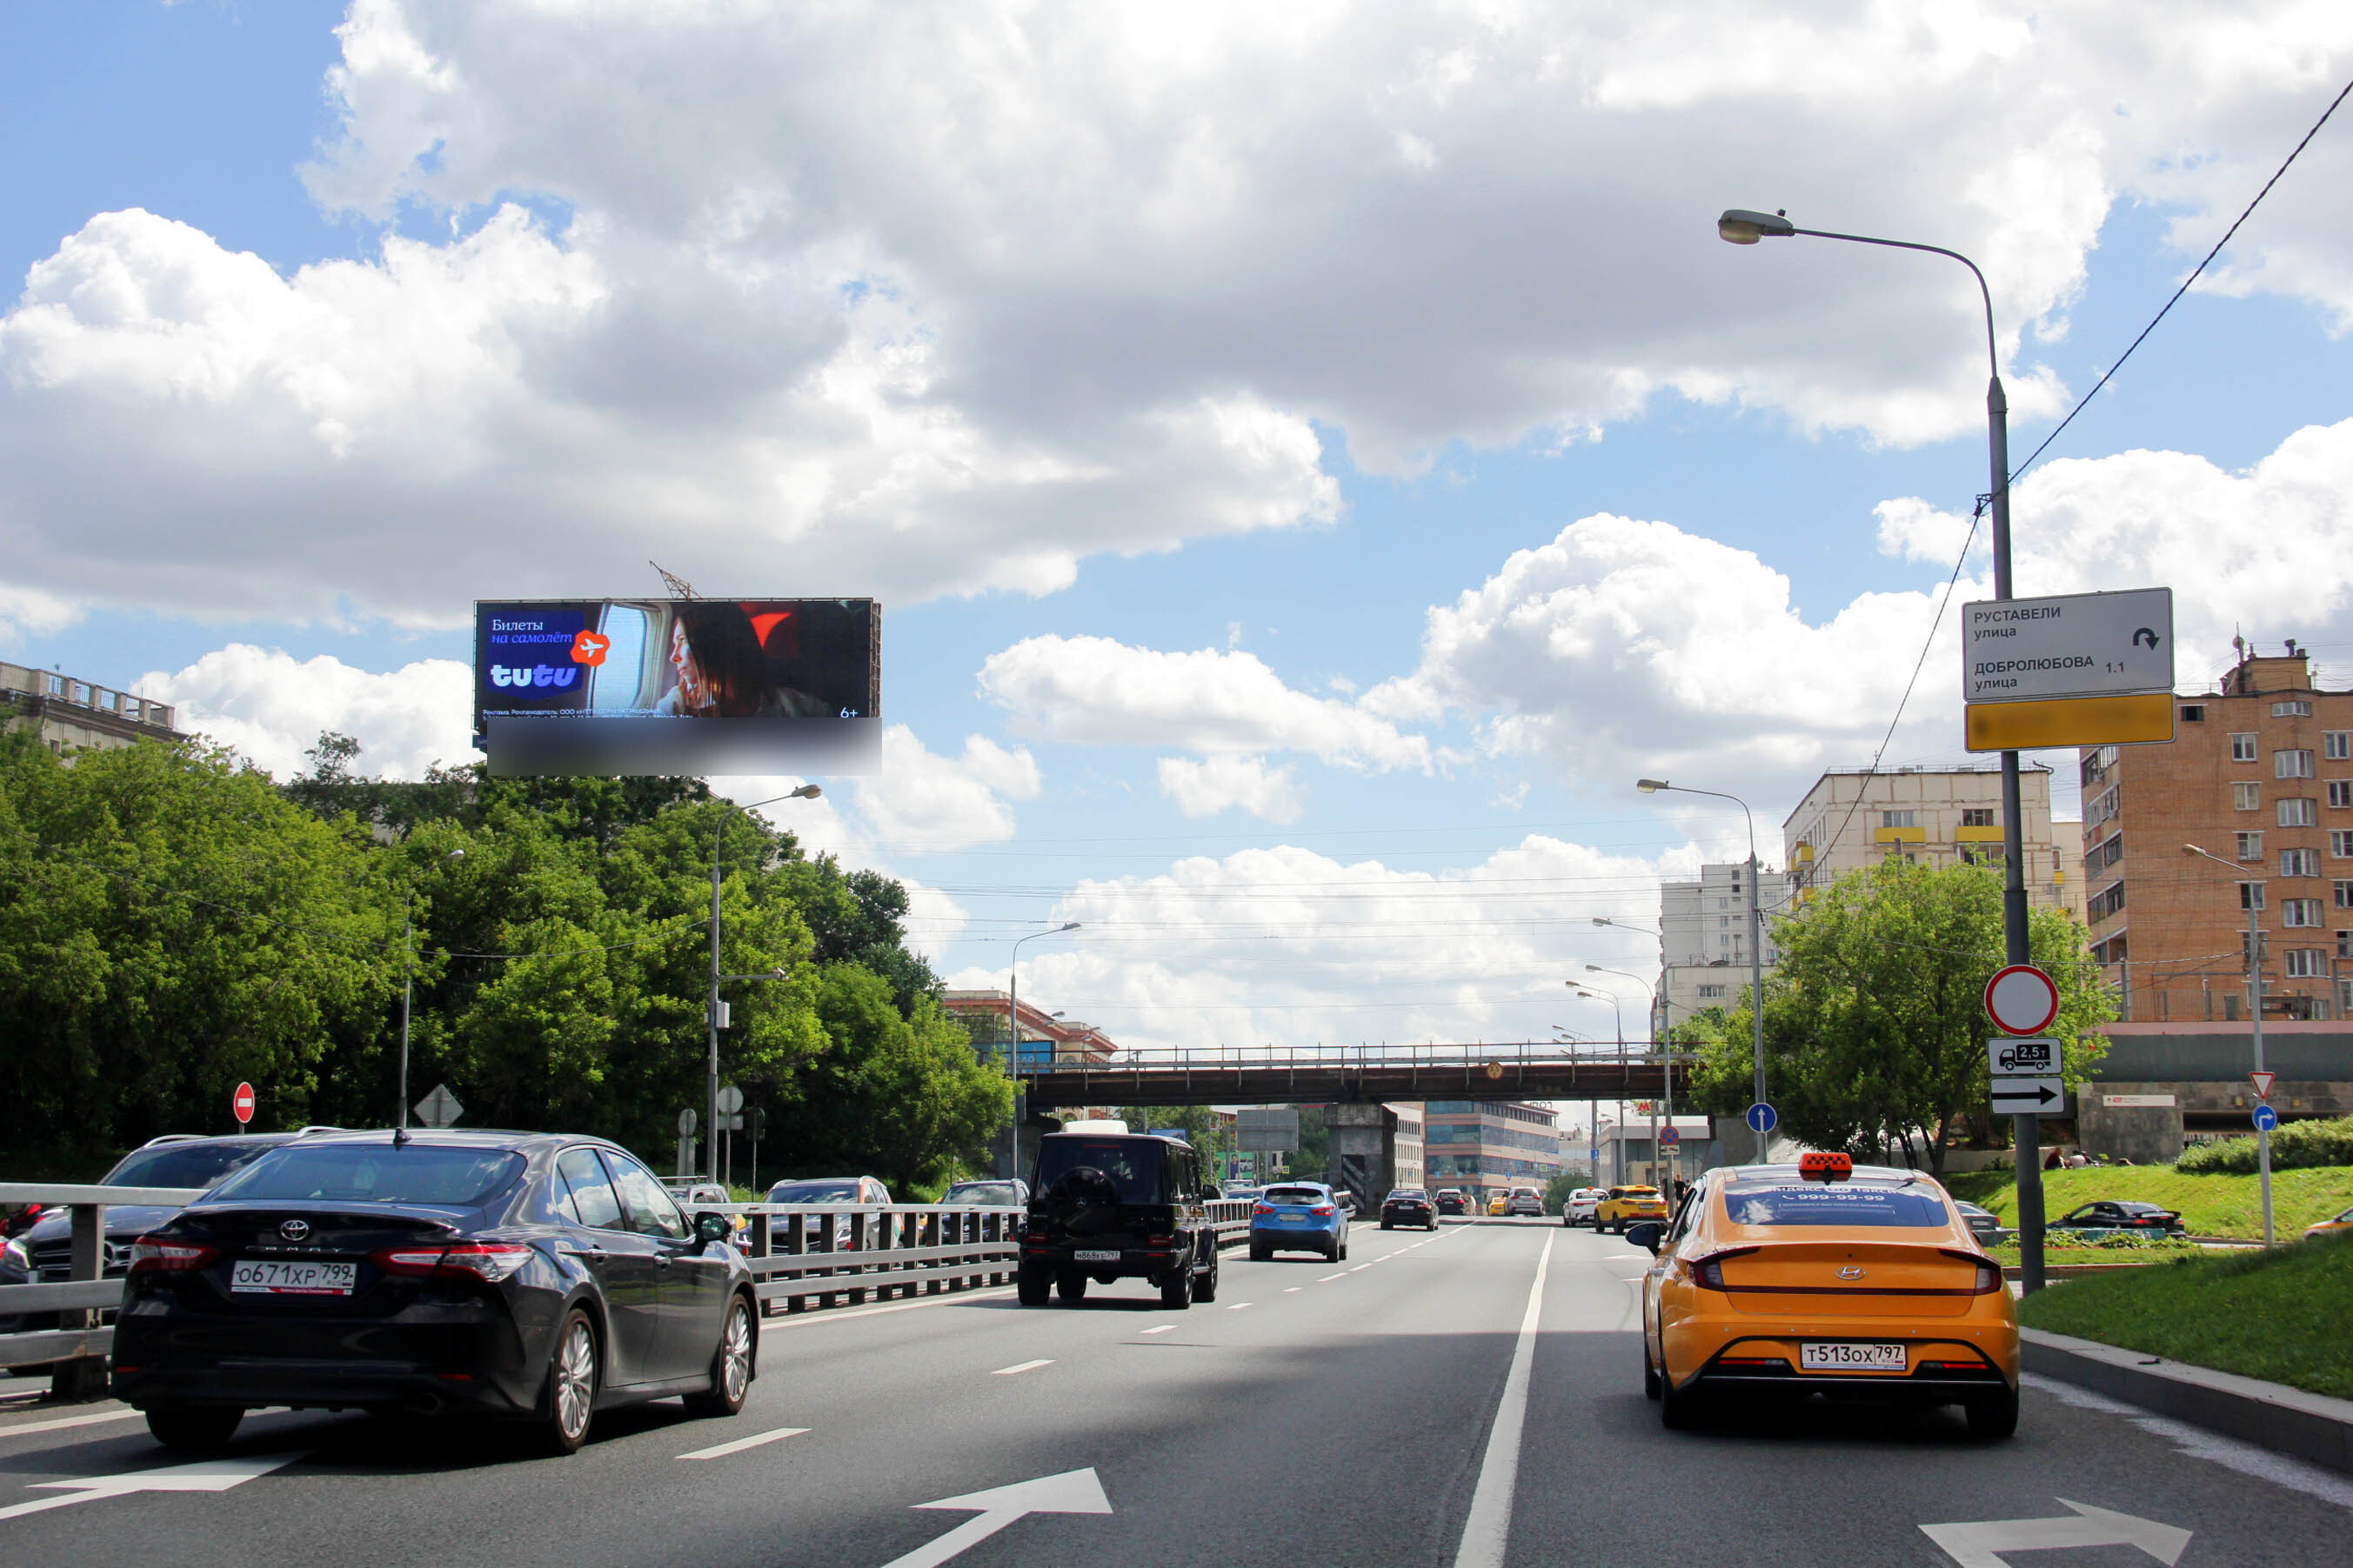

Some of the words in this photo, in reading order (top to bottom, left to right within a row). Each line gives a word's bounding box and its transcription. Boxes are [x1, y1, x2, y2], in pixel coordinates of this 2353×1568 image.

[1974, 607, 2061, 623] РУСТАВЕЛИ
[492, 619, 544, 631] Билеты
[491, 634, 508, 644] на
[511, 631, 572, 644] самолёт
[1974, 627, 2017, 641] улица
[1975, 656, 2095, 676] ДОБРОЛЮБОВА
[2106, 662, 2125, 673] 1.1
[491, 664, 578, 687] tutu
[1975, 678, 2018, 692] улица
[840, 706, 859, 717] 6+
[1875, 1346, 1901, 1358] 797
